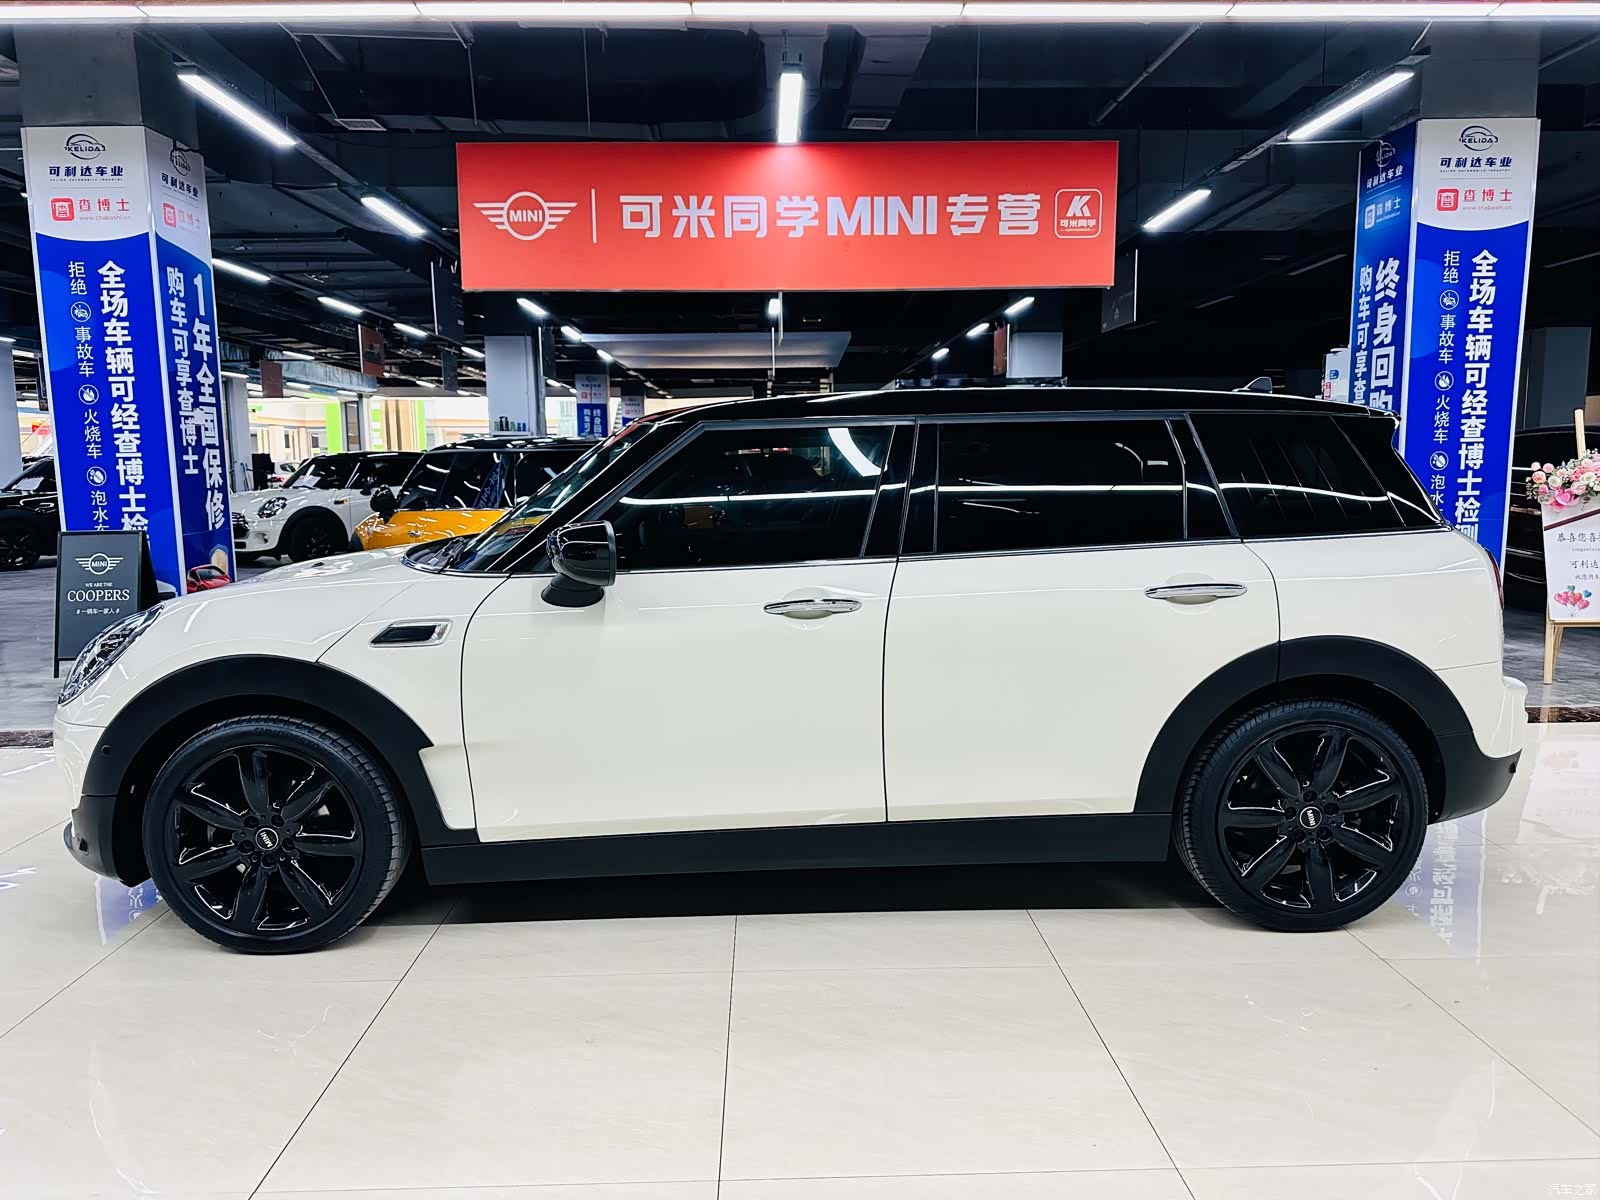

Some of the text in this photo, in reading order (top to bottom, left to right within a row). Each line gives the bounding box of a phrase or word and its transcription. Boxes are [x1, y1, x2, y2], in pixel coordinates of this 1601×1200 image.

[48, 165, 124, 177] 可利达车业
[1439, 156, 1512, 168] 可利达车业
[161, 172, 199, 198] 可利达车业
[1366, 165, 1404, 189] 可利达车业
[78, 198, 130, 212] 查博士
[1066, 195, 1092, 217] K
[1463, 189, 1513, 202] 查博士
[509, 210, 543, 223] MINI
[619, 193, 1041, 238] 可米同学MINI专营
[1060, 219, 1096, 228] 可米同学
[68, 261, 88, 295] 拒绝
[1353, 264, 1373, 404] 购车可享查
[74, 326, 95, 378] 事故车
[166, 266, 199, 475] 购车可享查博士
[1429, 250, 1460, 511] 拒绝 事故车 火烧车 泡水
[97, 260, 150, 548] 全场车辆可经查博士检
[192, 273, 225, 531] 1年全国保修
[84, 409, 103, 460] 火烧车
[1557, 532, 1600, 543] 恭喜您喜
[1570, 560, 1599, 569] 可利达
[67, 589, 130, 602] COOPERS
[1306, 809, 1316, 826] MINI
[260, 831, 274, 848] MINI
